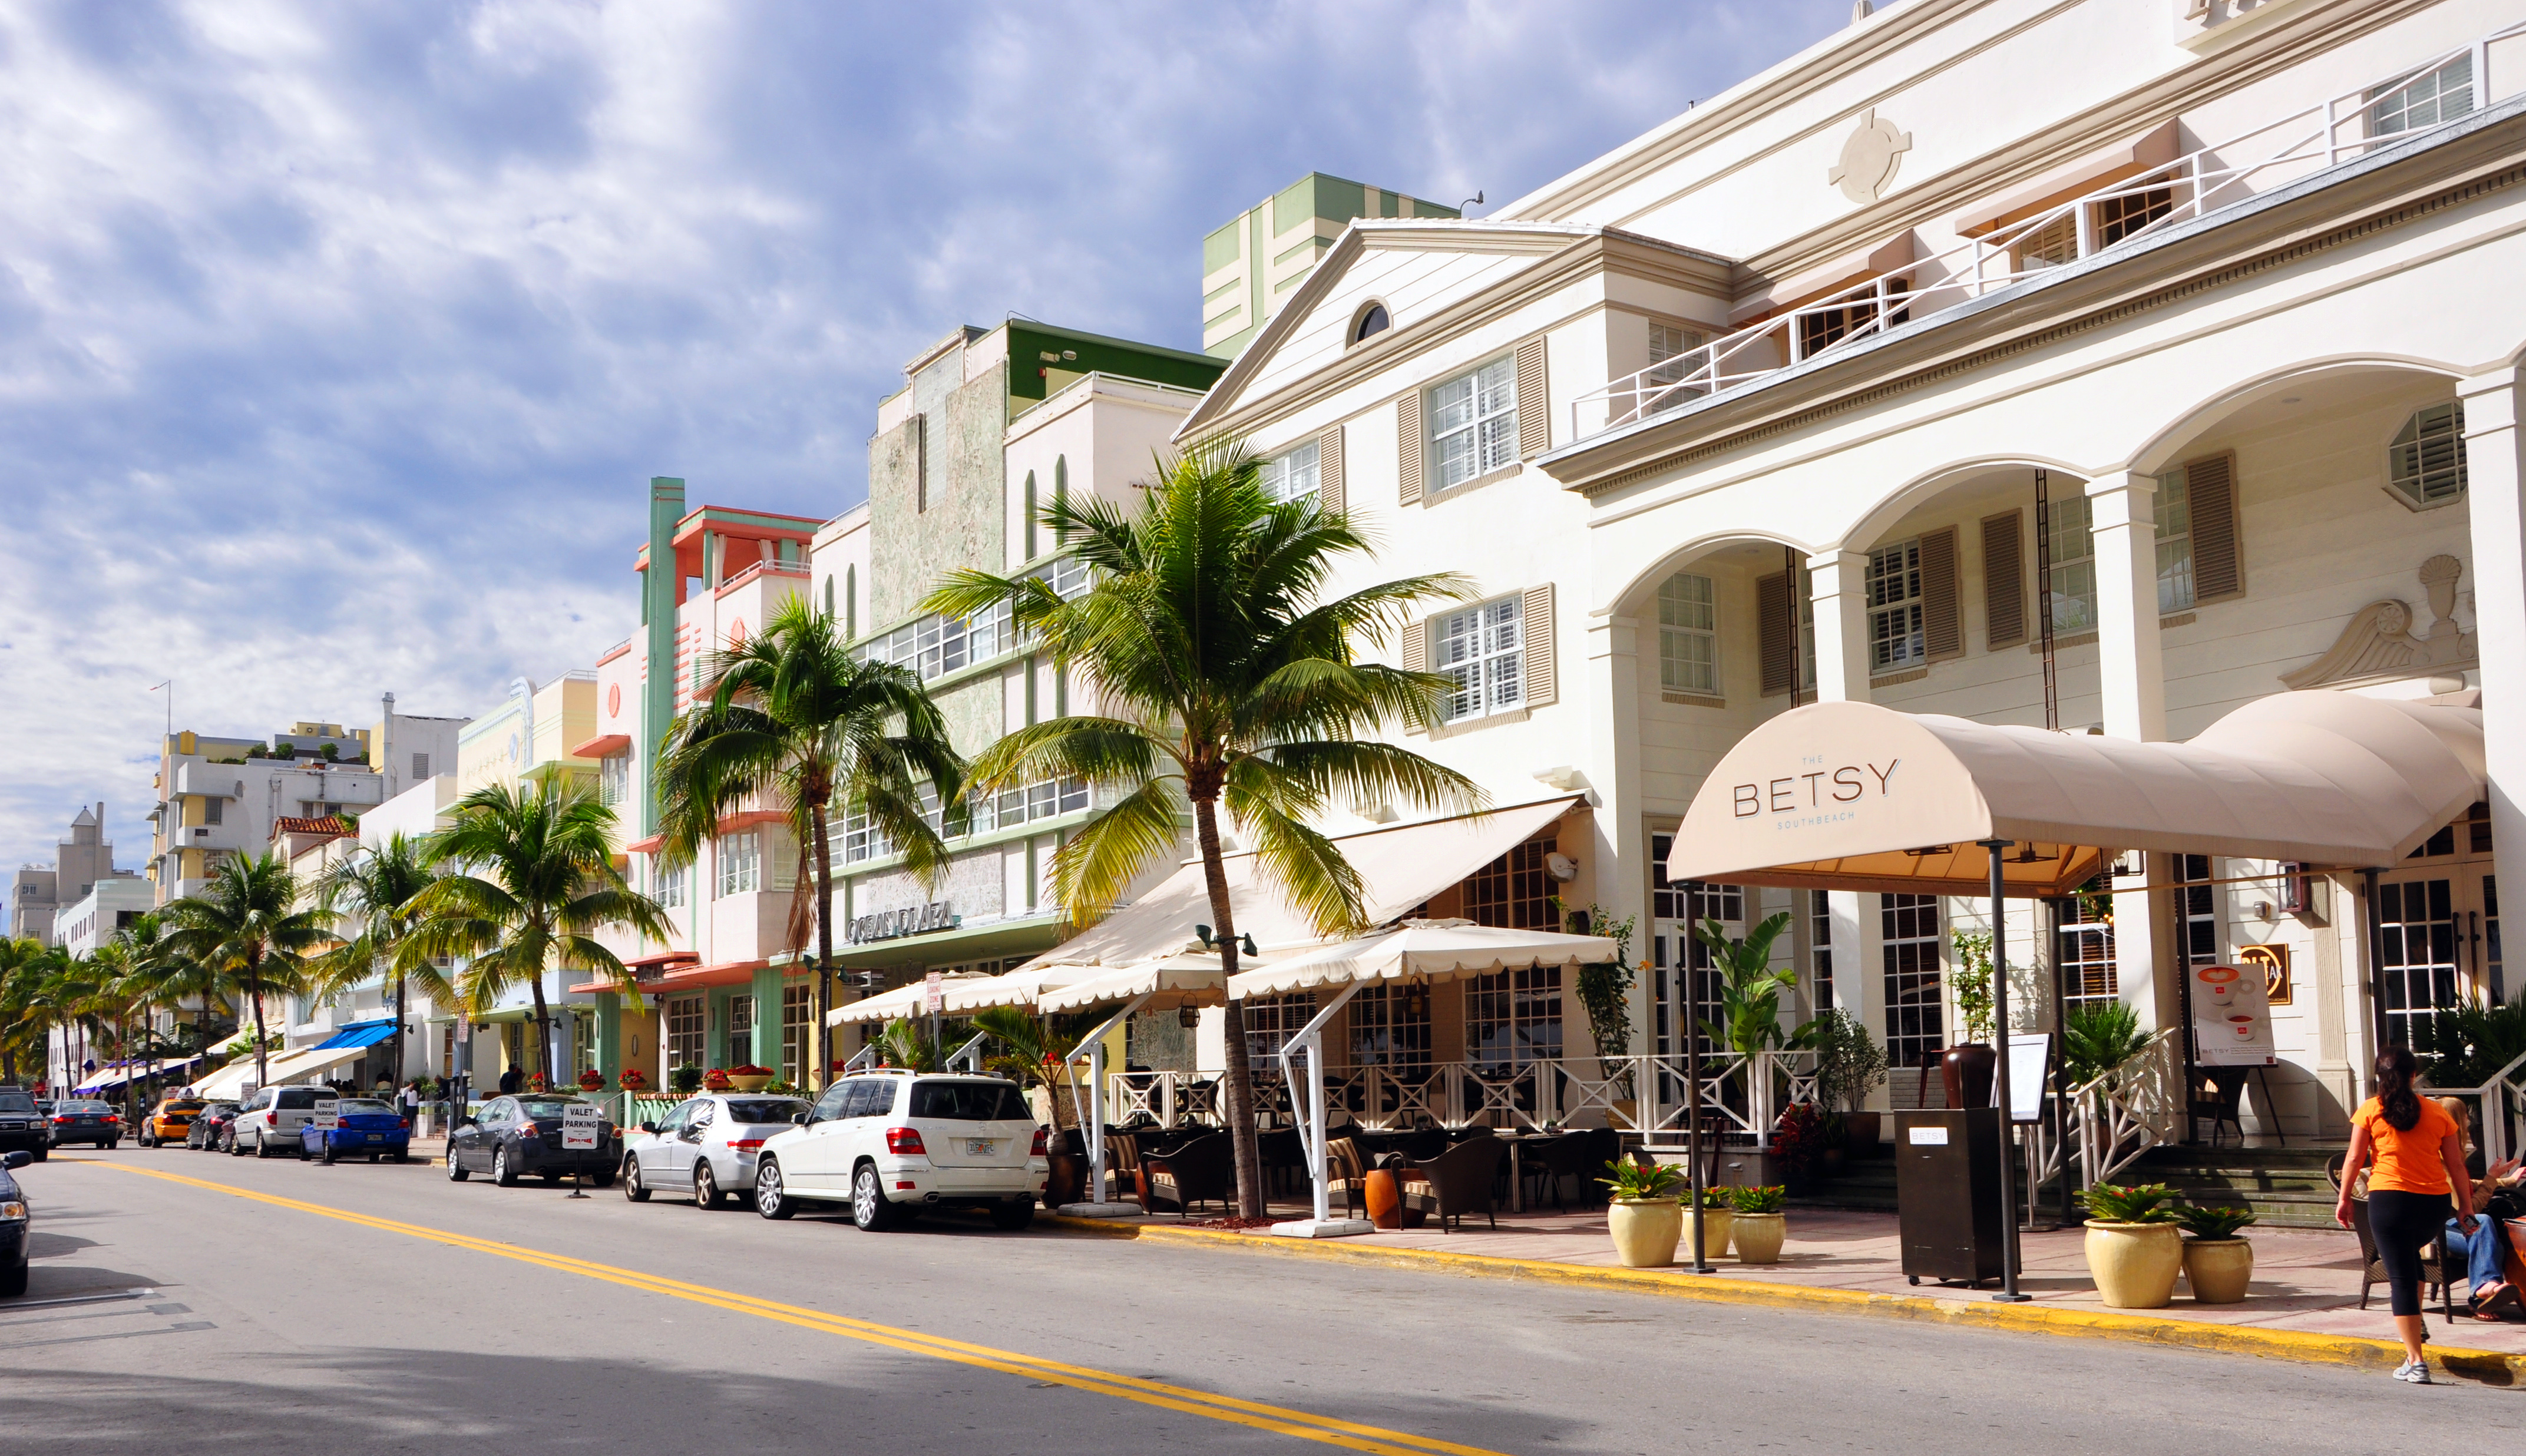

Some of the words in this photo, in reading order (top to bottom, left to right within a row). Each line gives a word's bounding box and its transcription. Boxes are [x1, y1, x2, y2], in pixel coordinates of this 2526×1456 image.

[1802, 755, 1823, 765] THE
[1734, 758, 1902, 820] BETSY
[1777, 812, 1855, 830] SOUTHBEACH
[847, 911, 897, 942] OCEAN
[898, 900, 954, 934] PLAZA
[570, 1108, 594, 1116] VALET
